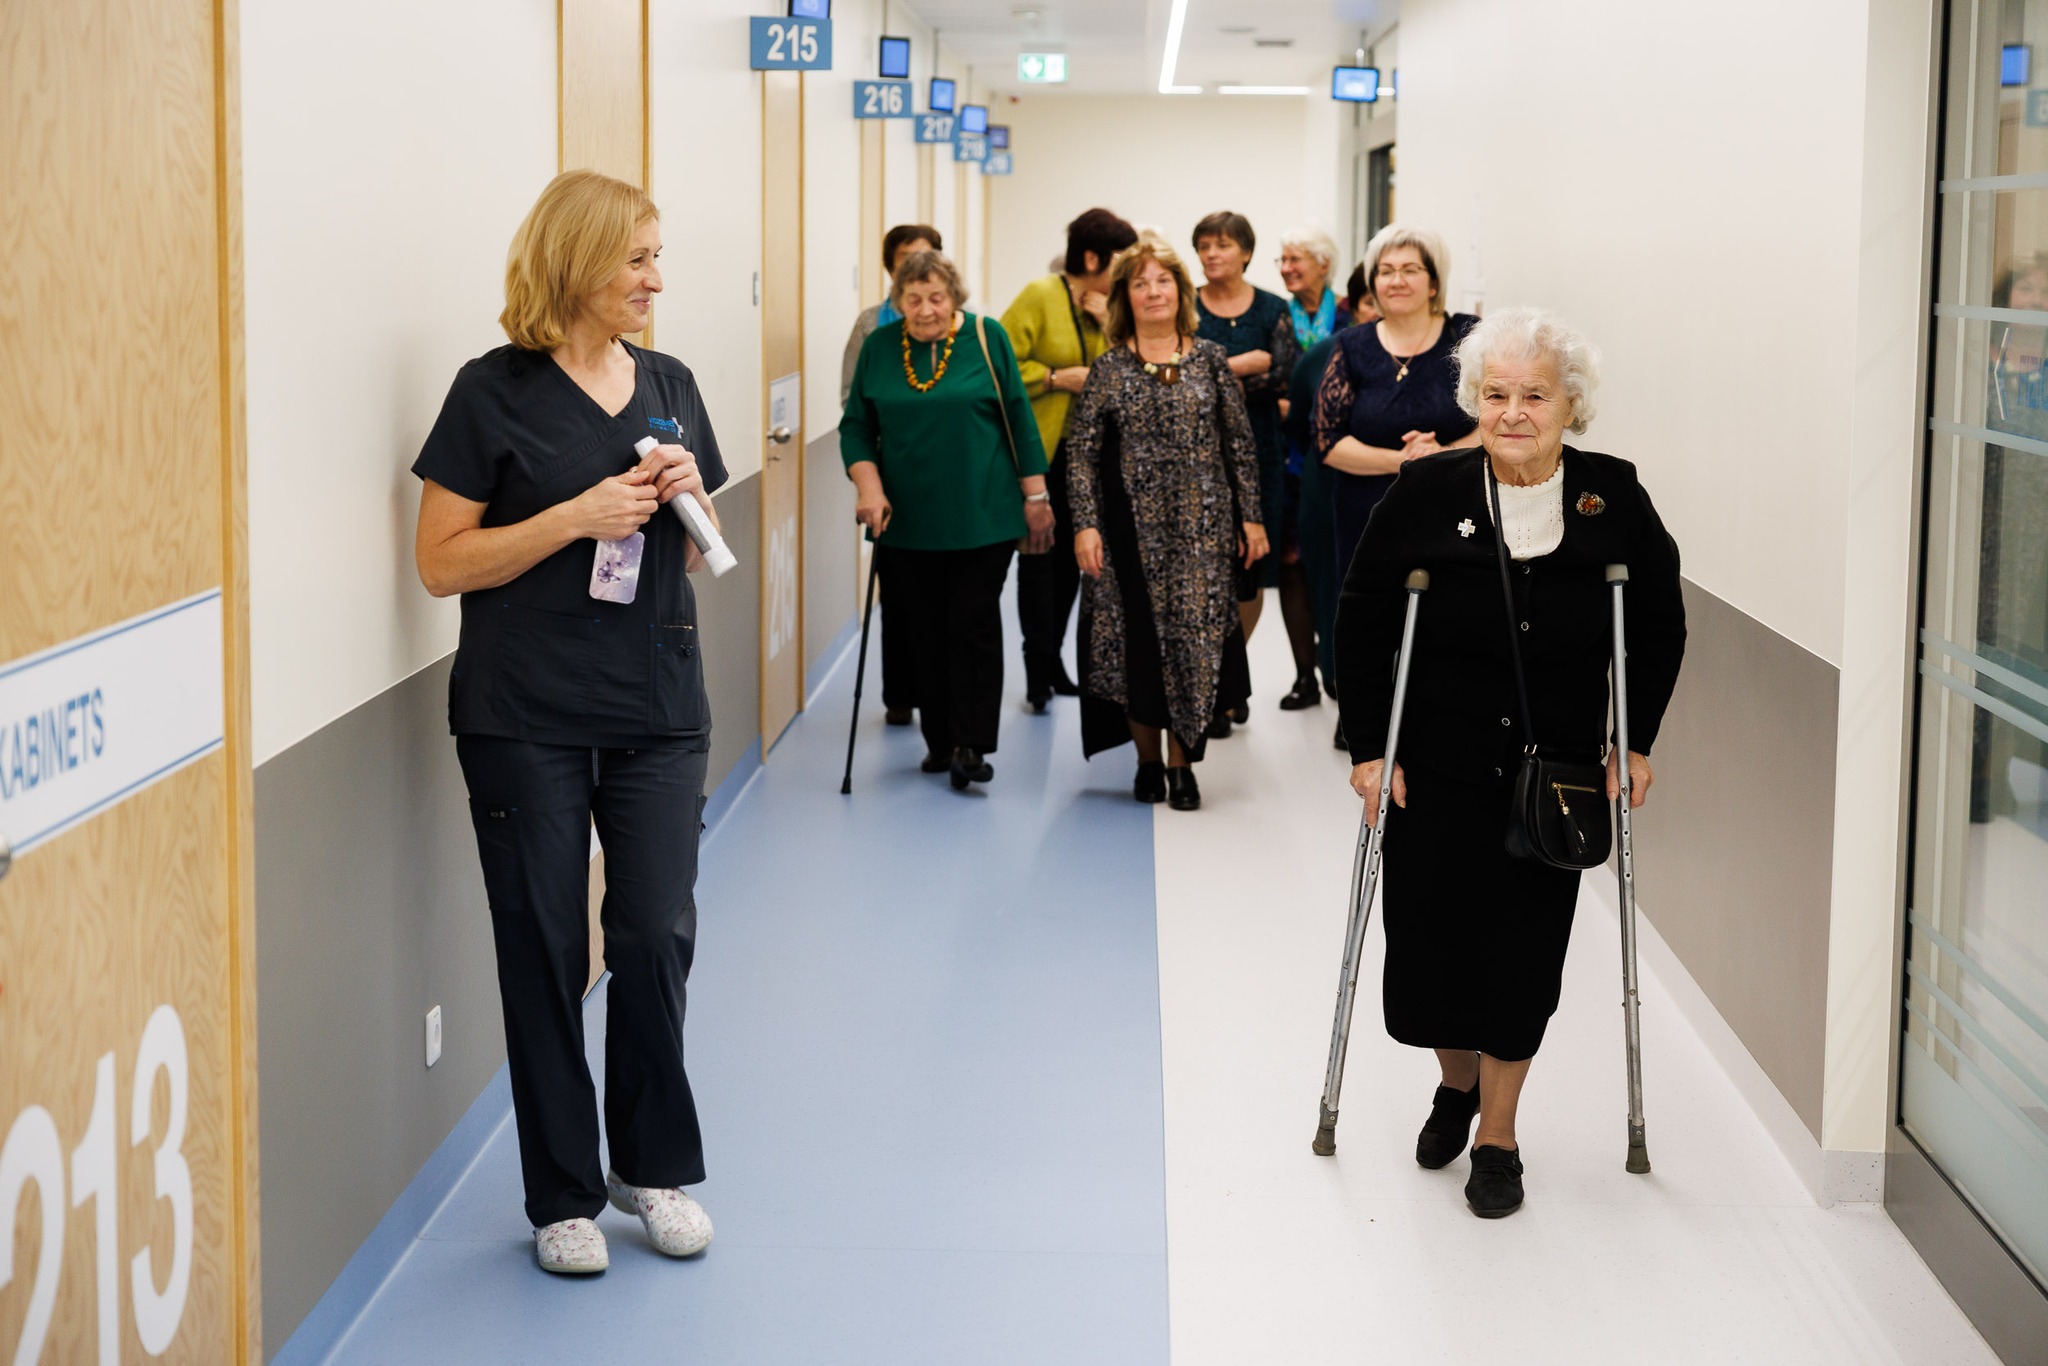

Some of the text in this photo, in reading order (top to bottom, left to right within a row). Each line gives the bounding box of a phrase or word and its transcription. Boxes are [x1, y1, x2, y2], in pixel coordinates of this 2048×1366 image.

[767, 24, 818, 62] 215
[863, 85, 903, 114] 216
[923, 117, 954, 141] 217
[0, 1004, 194, 1366] 213
